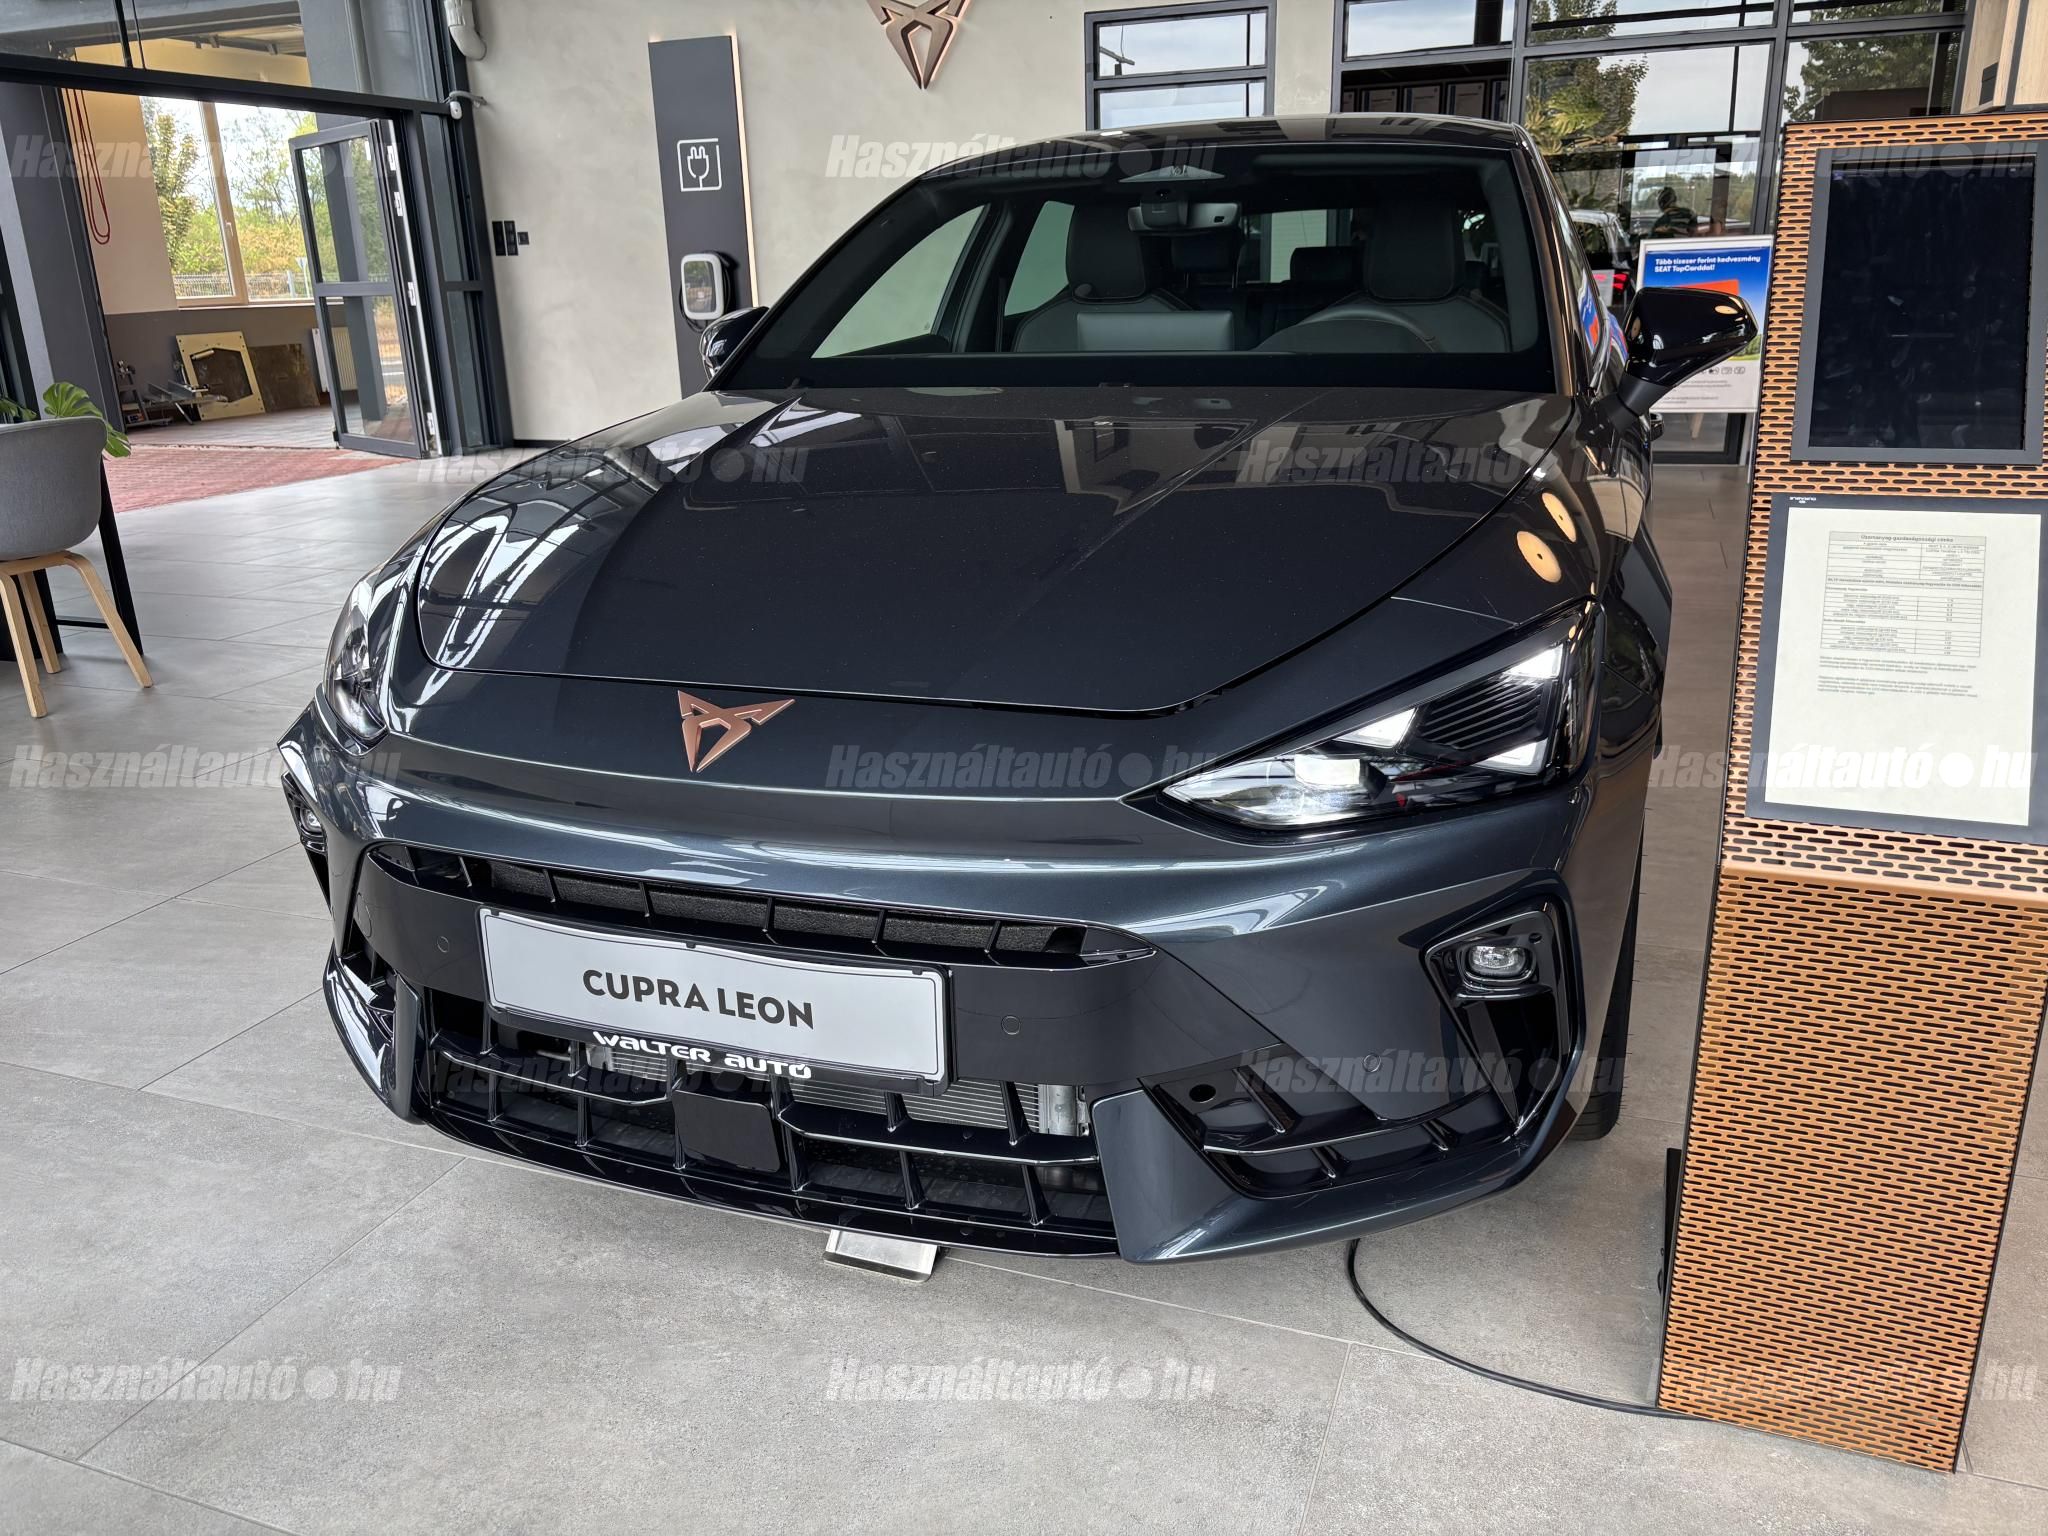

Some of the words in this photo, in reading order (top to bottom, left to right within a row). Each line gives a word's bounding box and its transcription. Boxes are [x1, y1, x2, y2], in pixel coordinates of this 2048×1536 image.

[1654, 265, 1671, 273] SEAT
[582, 969, 710, 1013] CUPRA
[717, 987, 814, 1030] LEON
